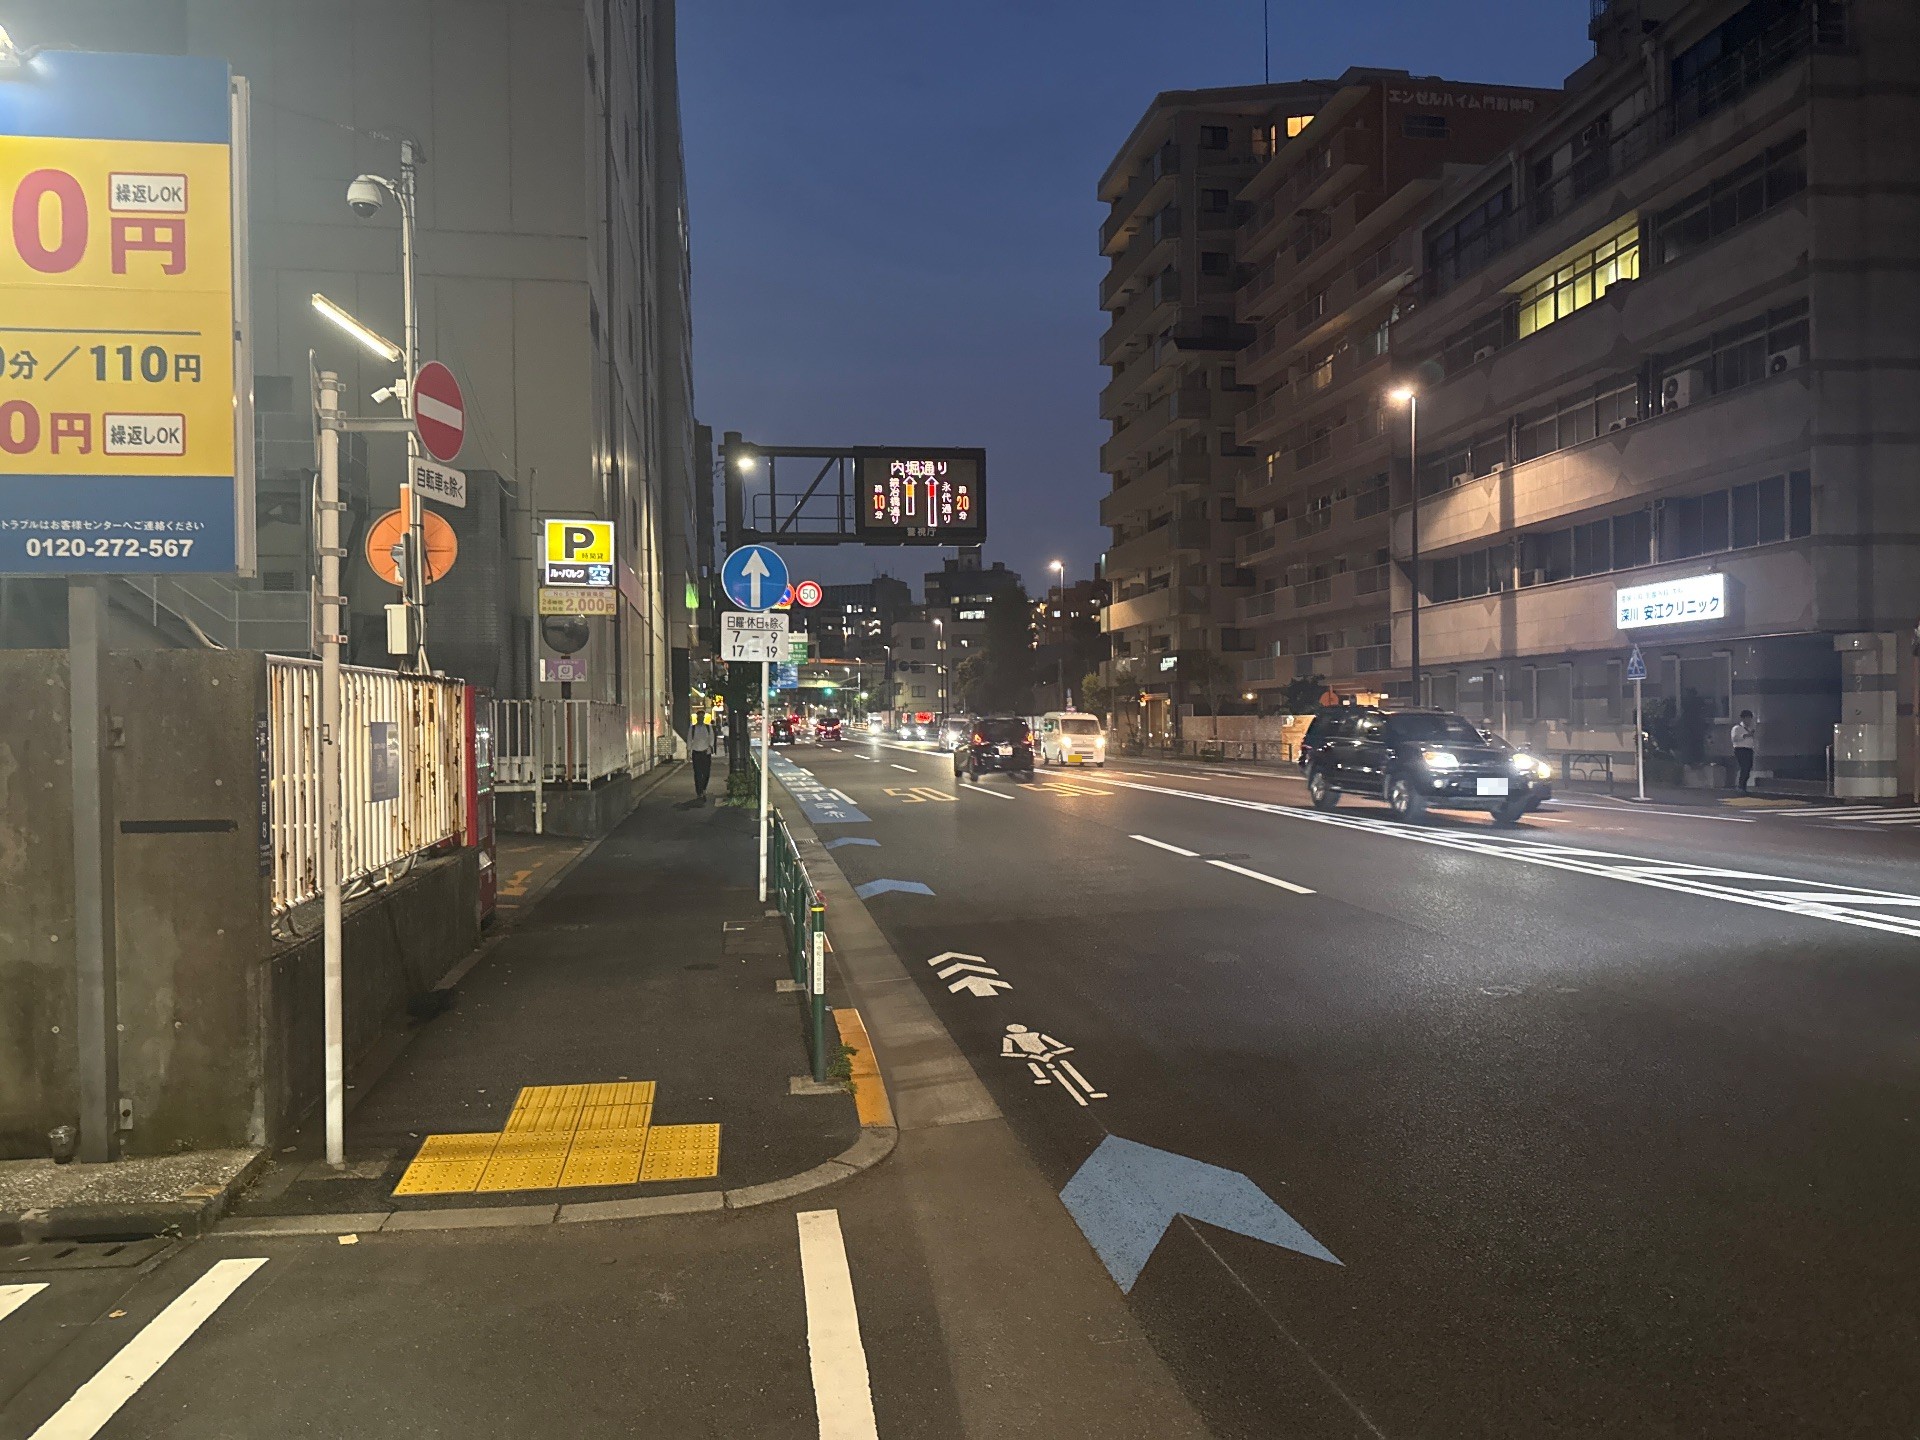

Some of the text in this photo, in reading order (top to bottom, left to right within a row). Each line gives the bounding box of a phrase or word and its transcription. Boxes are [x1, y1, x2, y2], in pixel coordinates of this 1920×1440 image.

[115, 184, 183, 203] 繰返しOK
[110, 425, 180, 445] 繰返しOK
[890, 460, 947, 478] 内堀通り
[417, 466, 464, 500] 自転車を除く
[941, 481, 953, 524] 永代通り
[26, 538, 194, 558] 0120-272-567
[565, 527, 595, 559] P
[802, 588, 817, 600] 50
[1643, 597, 1720, 621] 安江クリニック
[882, 787, 960, 803] 50
